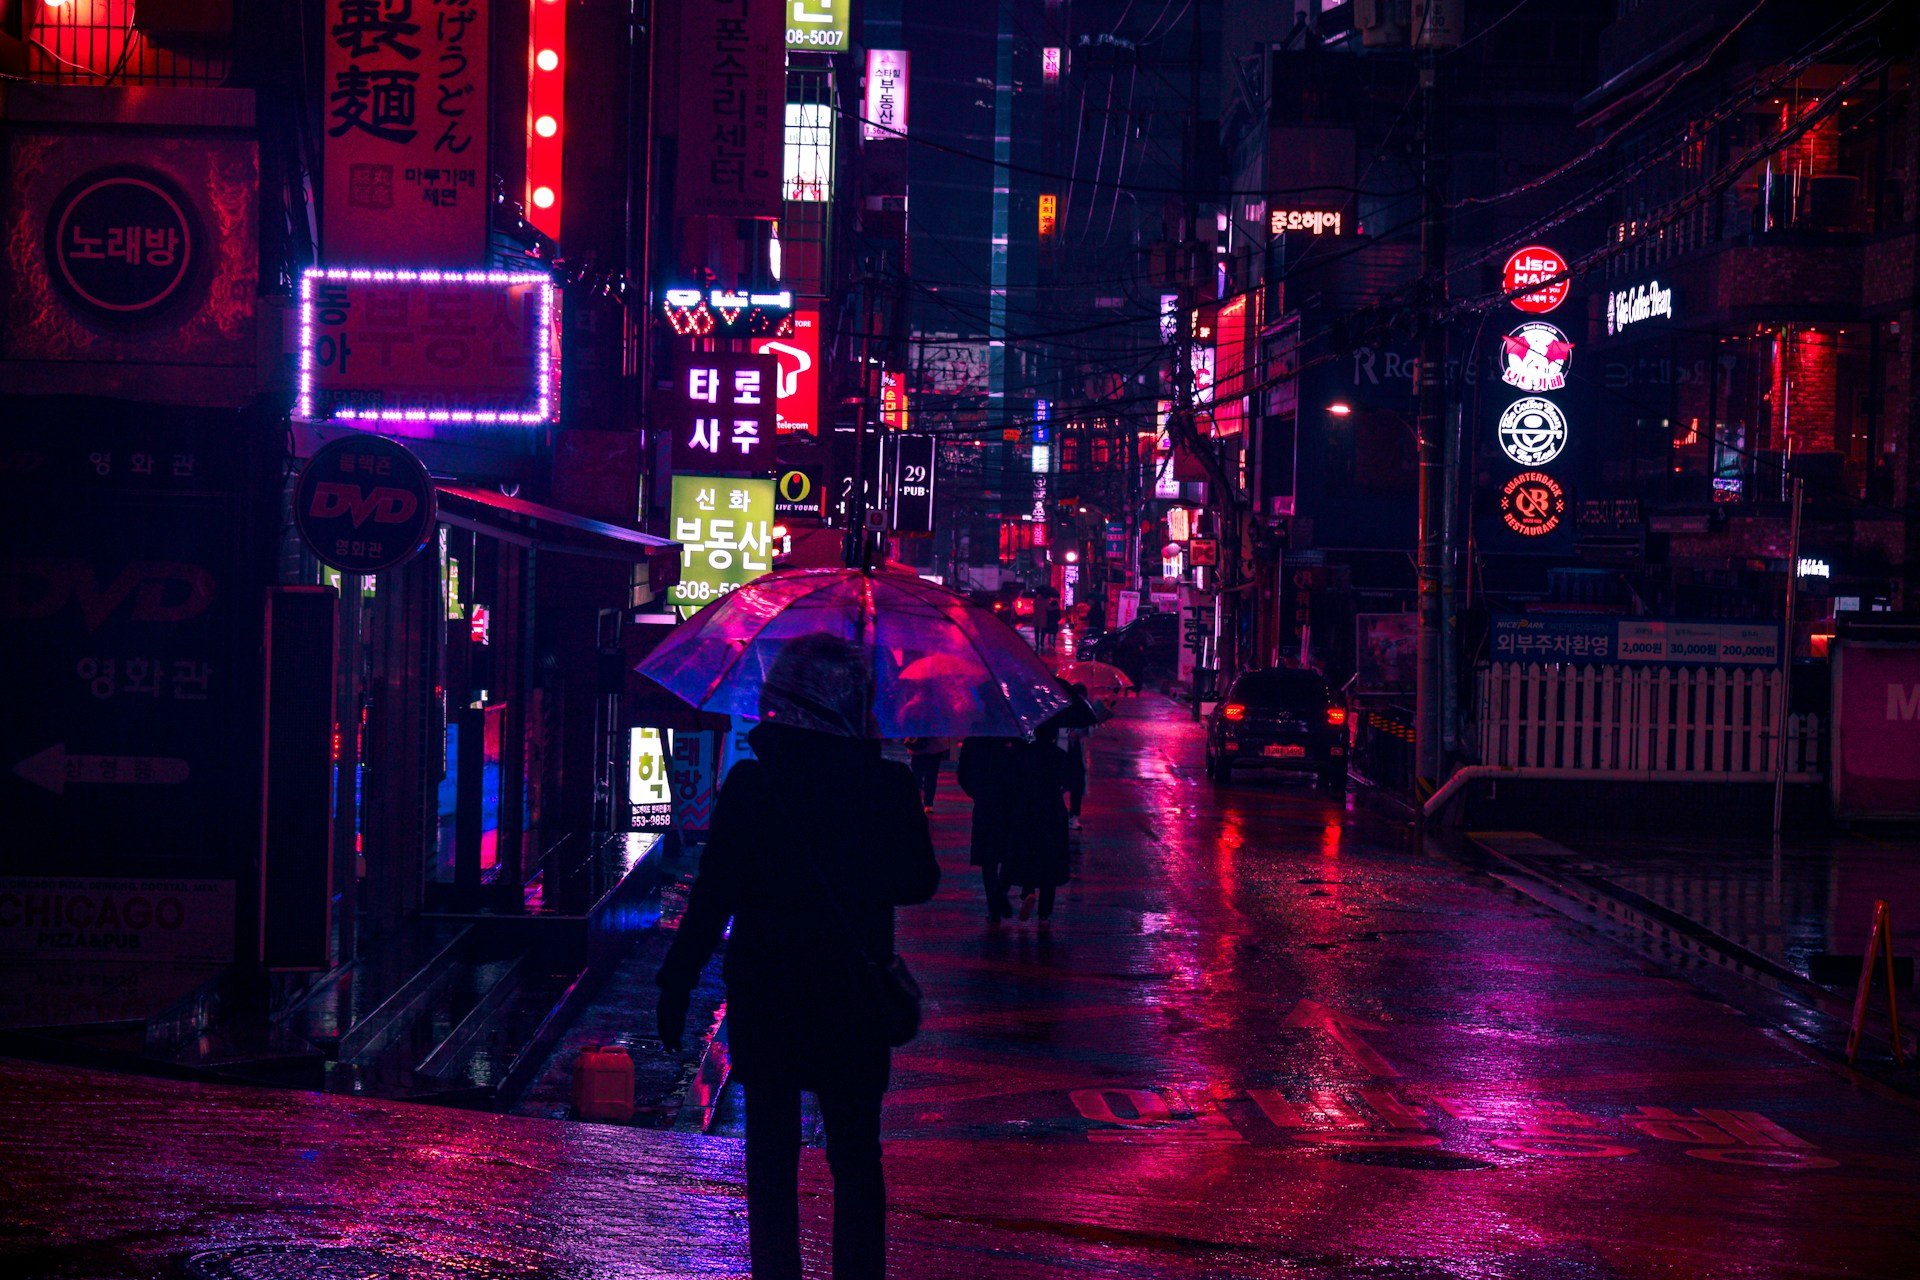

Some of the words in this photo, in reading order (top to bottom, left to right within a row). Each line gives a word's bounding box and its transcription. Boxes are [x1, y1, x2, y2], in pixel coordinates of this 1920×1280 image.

[434, 0, 477, 153] げうどん
[875, 69, 900, 78] 스타힐
[879, 79, 895, 125] 부동산
[422, 189, 457, 207] 제면
[1271, 210, 1341, 236] 준오헤어
[69, 226, 178, 266] 노래방
[1629, 285, 1650, 323] Coffee
[1650, 281, 1672, 319] Bean
[358, 291, 532, 368] 부동산
[689, 368, 761, 404] 타로
[1514, 400, 1543, 415] Coffee
[1543, 403, 1562, 431] Bean
[688, 418, 760, 454] 사주
[904, 465, 926, 482] 29
[1504, 472, 1563, 498] QUARTERBACK
[309, 481, 418, 529] DVD
[695, 488, 751, 512] 신화
[794, 504, 818, 512] YOUNG
[1515, 489, 1549, 517] QB
[1503, 513, 1559, 536] RESTAURANT
[335, 538, 384, 557] 영화관
[676, 517, 771, 571] 부동산
[1497, 634, 1609, 656] 외부주차환영
[1622, 642, 1663, 654] 2,000원
[1670, 643, 1717, 656] 30,000원
[1722, 645, 1775, 657] 200,000원
[76, 655, 214, 700] 영화관
[0, 892, 186, 929] CHICAGO
